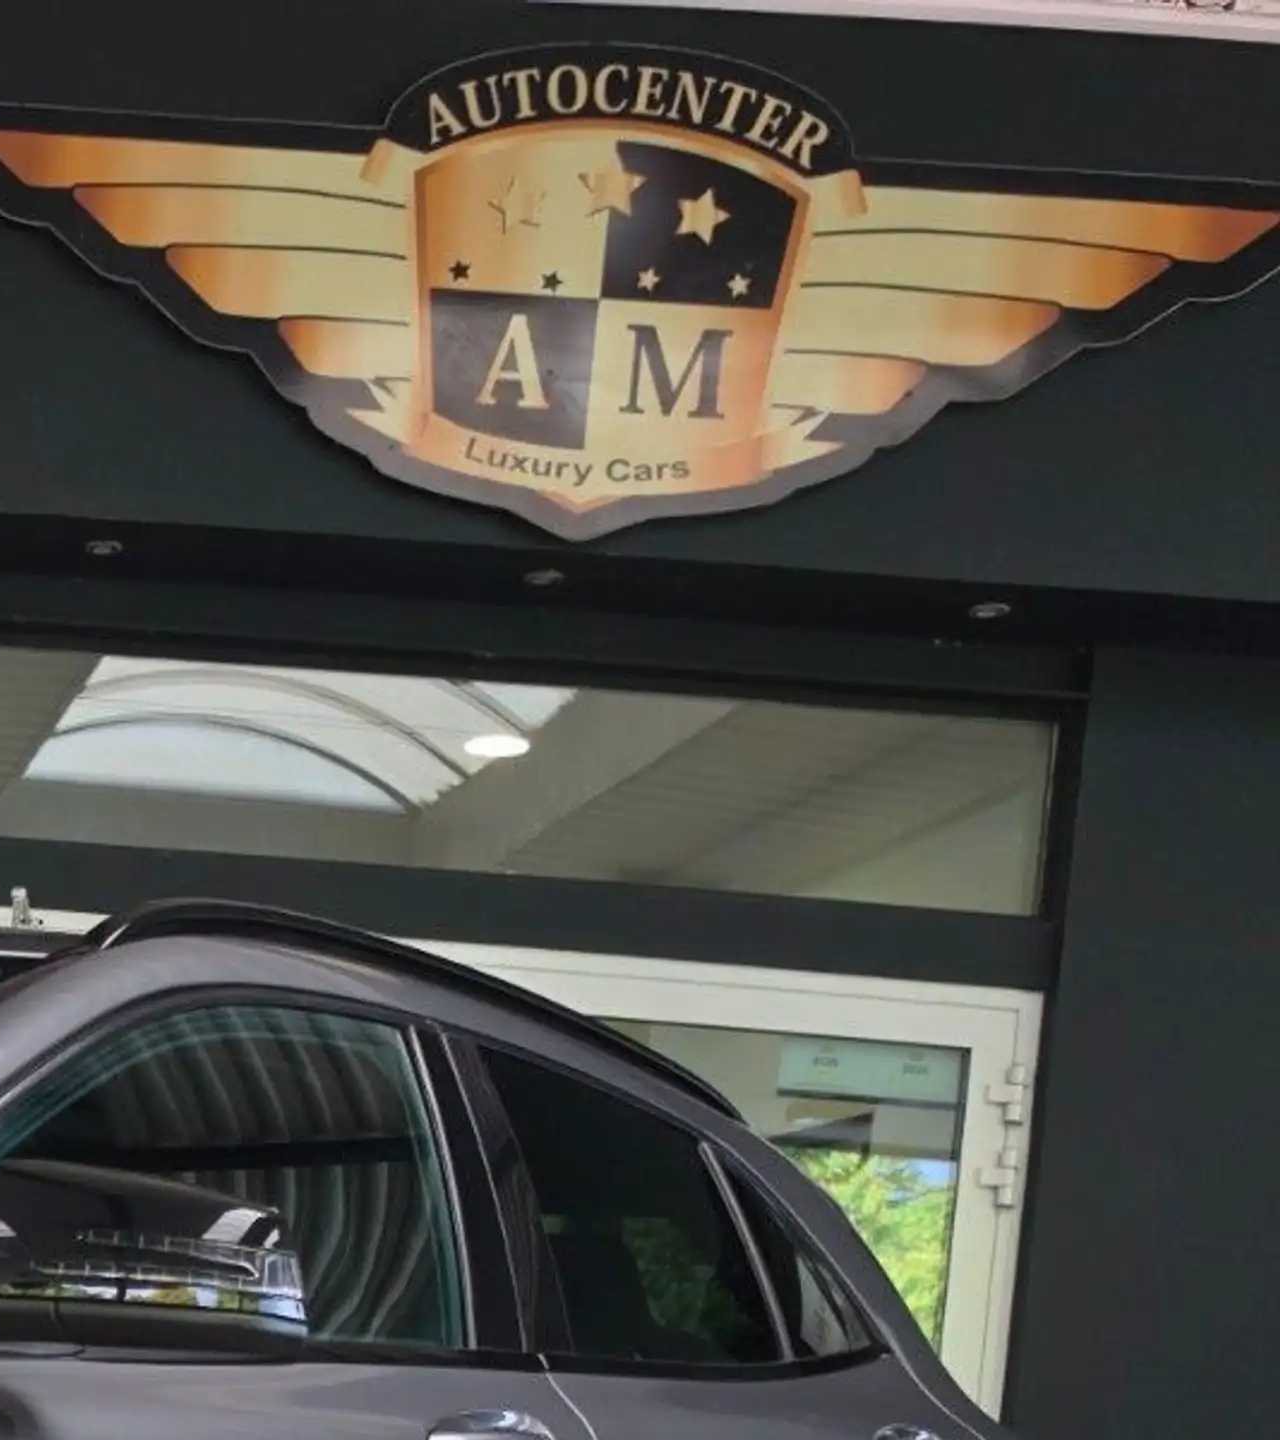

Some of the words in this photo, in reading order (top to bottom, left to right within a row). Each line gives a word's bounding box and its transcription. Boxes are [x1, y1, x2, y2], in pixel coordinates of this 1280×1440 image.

[426, 64, 830, 170] AUTOCENTER
[474, 312, 550, 410] A
[618, 323, 735, 421] M
[463, 436, 594, 487] Luxury
[605, 457, 692, 484] Cars
